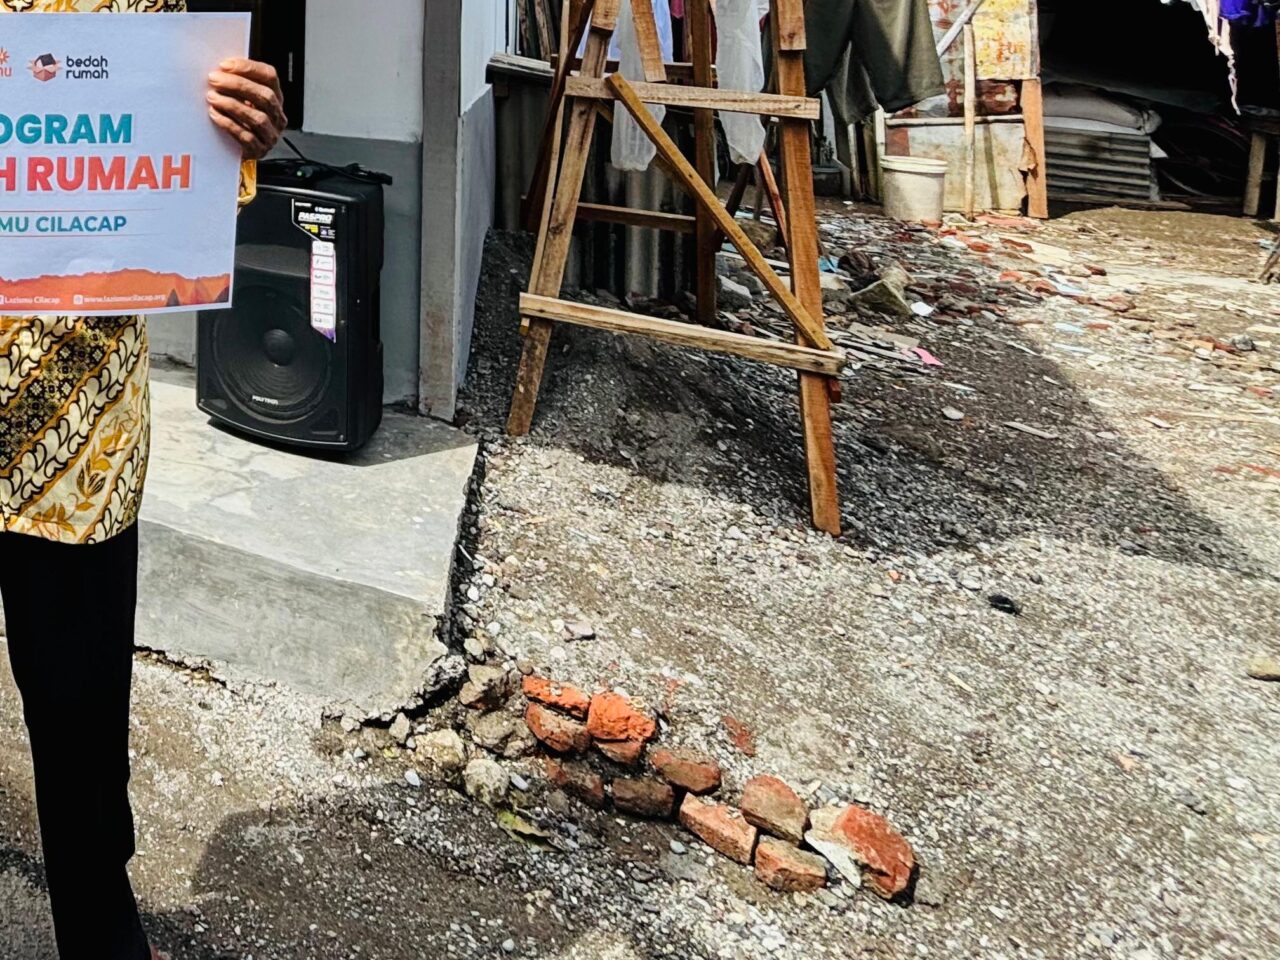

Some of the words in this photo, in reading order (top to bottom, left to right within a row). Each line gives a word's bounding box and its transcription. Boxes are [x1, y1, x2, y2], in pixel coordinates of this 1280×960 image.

[65, 55, 109, 68] bedah
[65, 67, 109, 80] rumah
[26, 154, 192, 191] RUMAH
[35, 215, 127, 233] CILACAP
[33, 296, 60, 305] Cilacap
